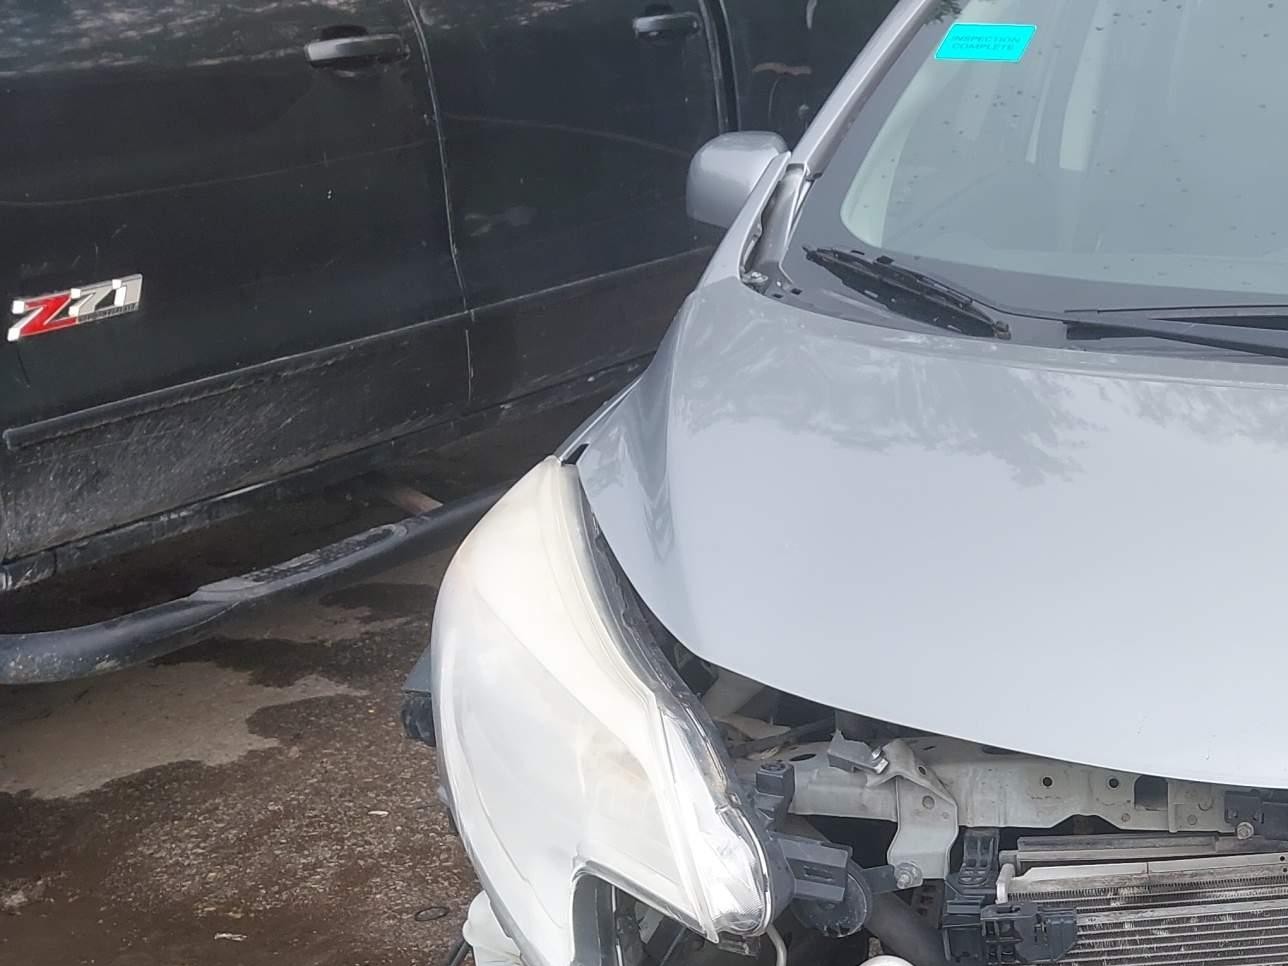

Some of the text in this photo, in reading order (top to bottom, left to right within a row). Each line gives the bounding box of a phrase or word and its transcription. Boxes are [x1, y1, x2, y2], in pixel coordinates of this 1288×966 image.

[951, 35, 1021, 43] INSPECTION
[952, 42, 1015, 50] COMPLETE
[7, 273, 143, 342] Z71
